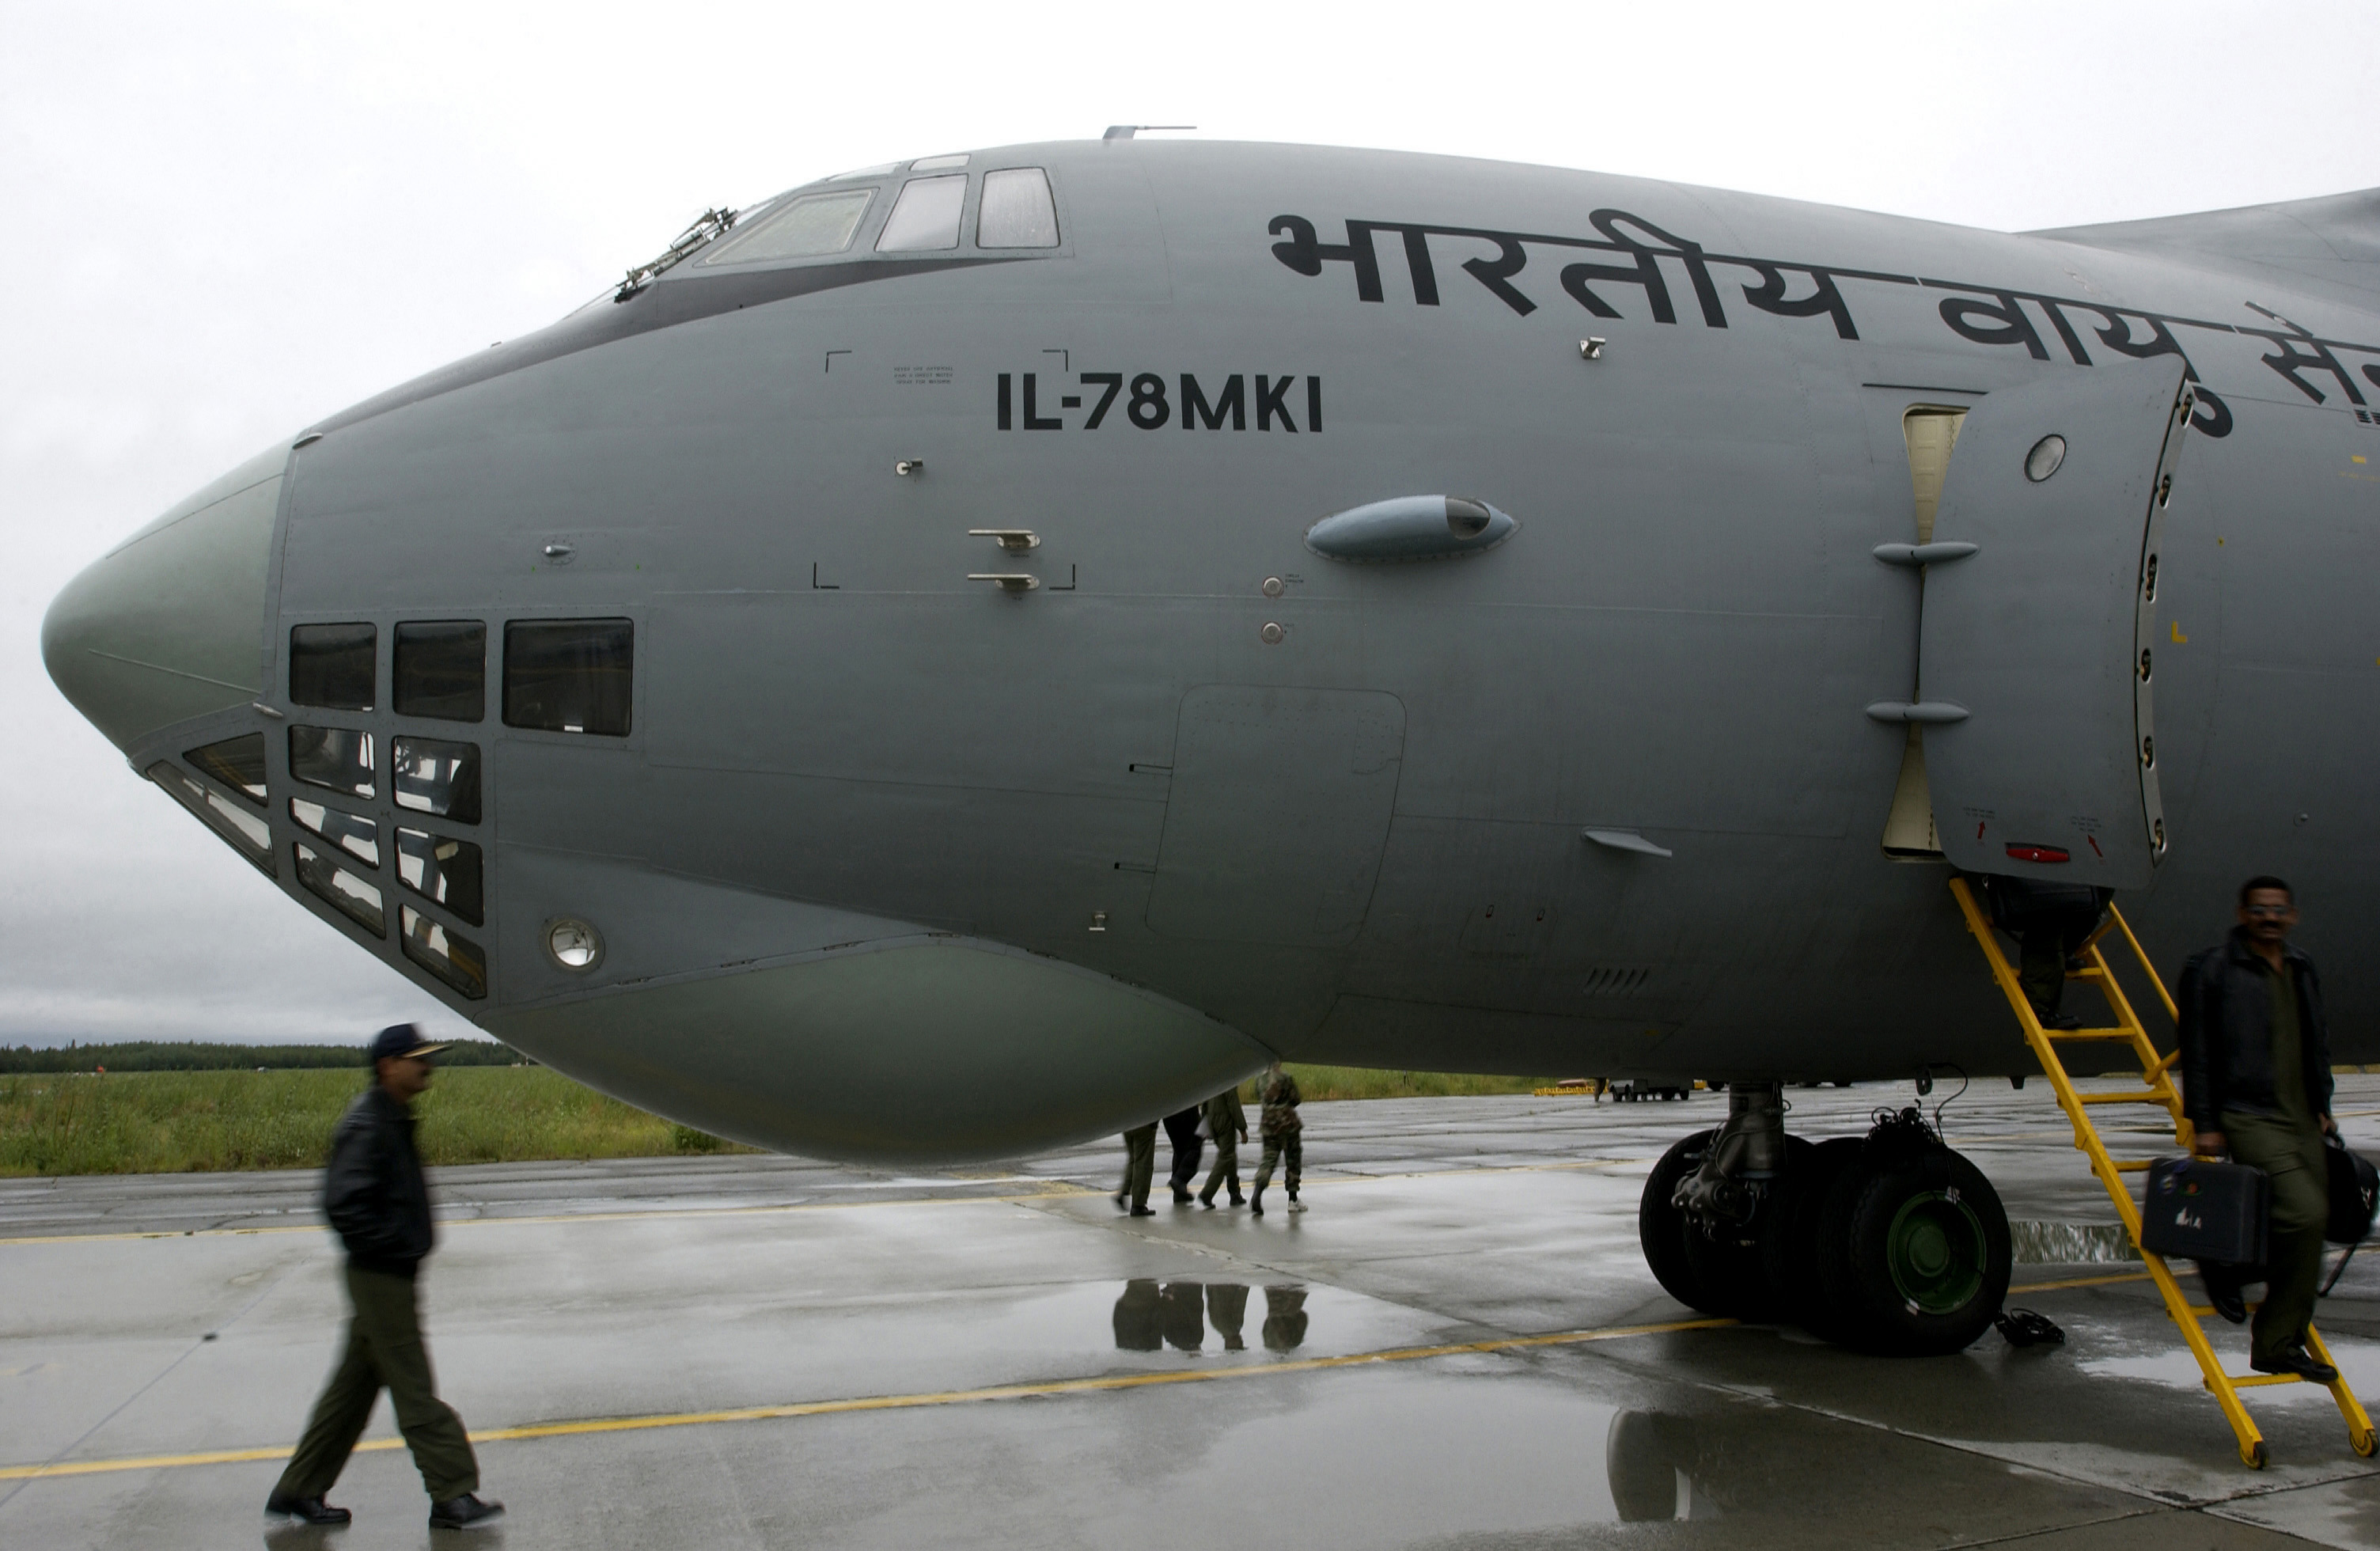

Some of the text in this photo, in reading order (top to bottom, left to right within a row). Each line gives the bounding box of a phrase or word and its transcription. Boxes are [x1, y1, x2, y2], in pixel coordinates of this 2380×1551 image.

[1268, 208, 2380, 438] भारतीय वायु से
[997, 373, 1322, 432] IL-78MKI
